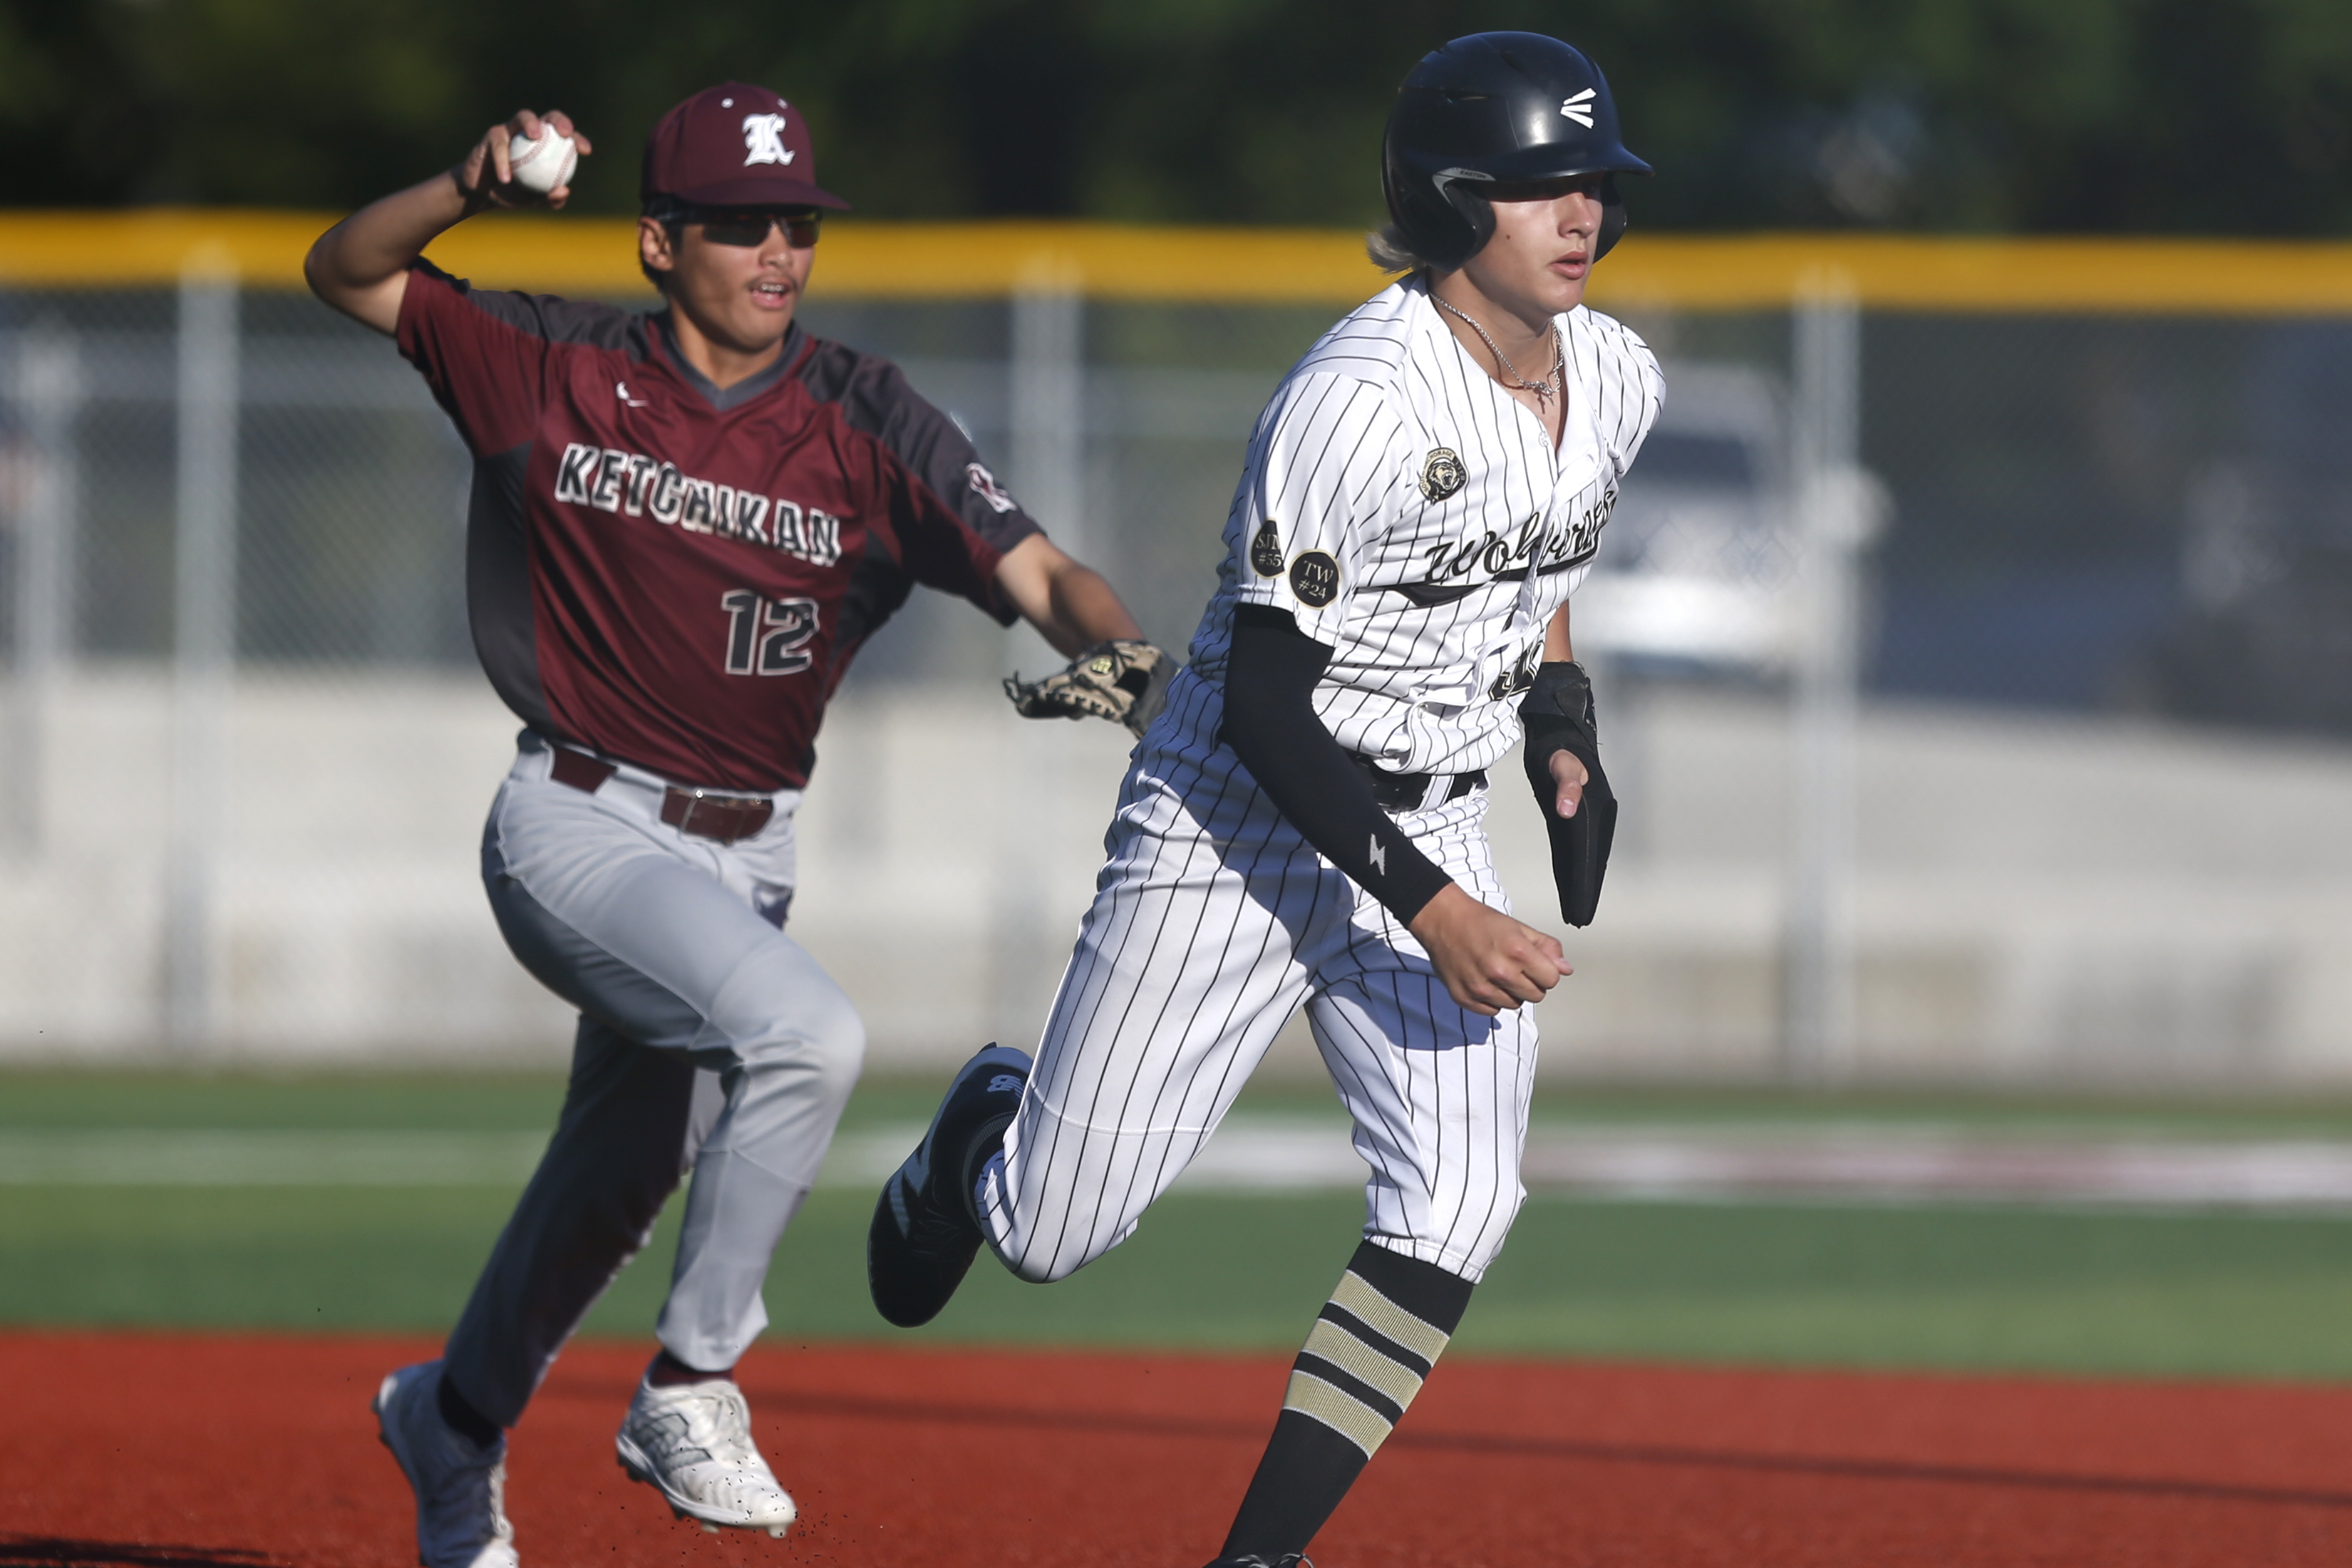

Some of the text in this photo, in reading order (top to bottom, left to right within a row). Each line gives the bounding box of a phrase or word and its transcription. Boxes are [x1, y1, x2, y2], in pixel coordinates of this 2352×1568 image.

[1460, 170, 1487, 179] EASTON
[555, 443, 842, 567] KETCHIKAN
[1425, 490, 1617, 582] Wolernes
[1258, 552, 1281, 567] #55
[1304, 560, 1334, 584] TW
[1298, 579, 1327, 599] #24
[721, 589, 819, 676] 12
